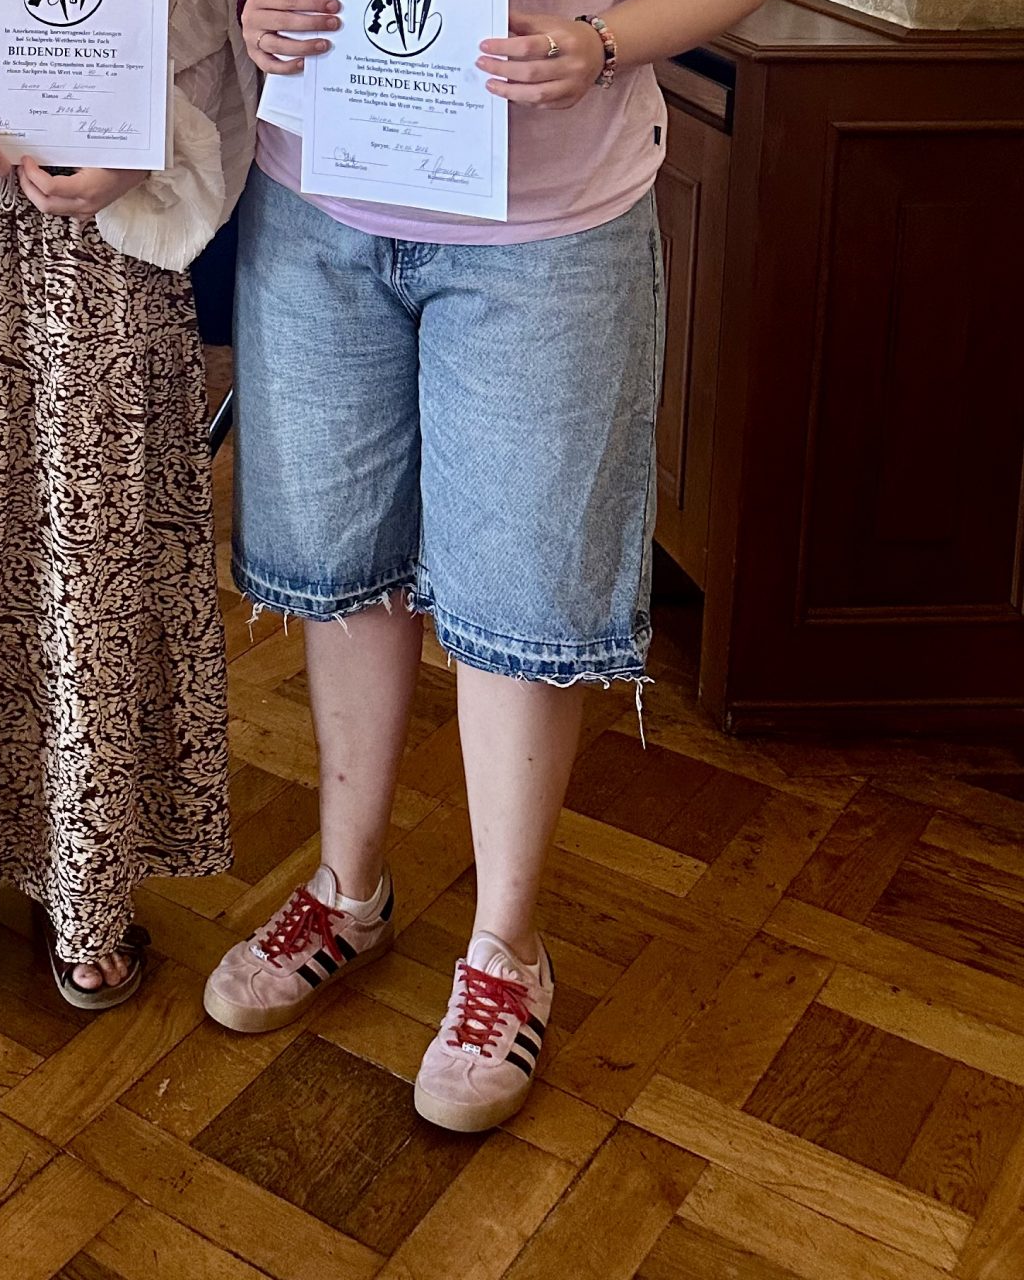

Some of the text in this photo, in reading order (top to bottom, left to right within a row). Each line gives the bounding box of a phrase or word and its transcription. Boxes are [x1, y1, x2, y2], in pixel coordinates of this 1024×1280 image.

[8, 46, 118, 59] BILDENDE KUNST
[349, 74, 457, 95] BILDENDE KUNST
